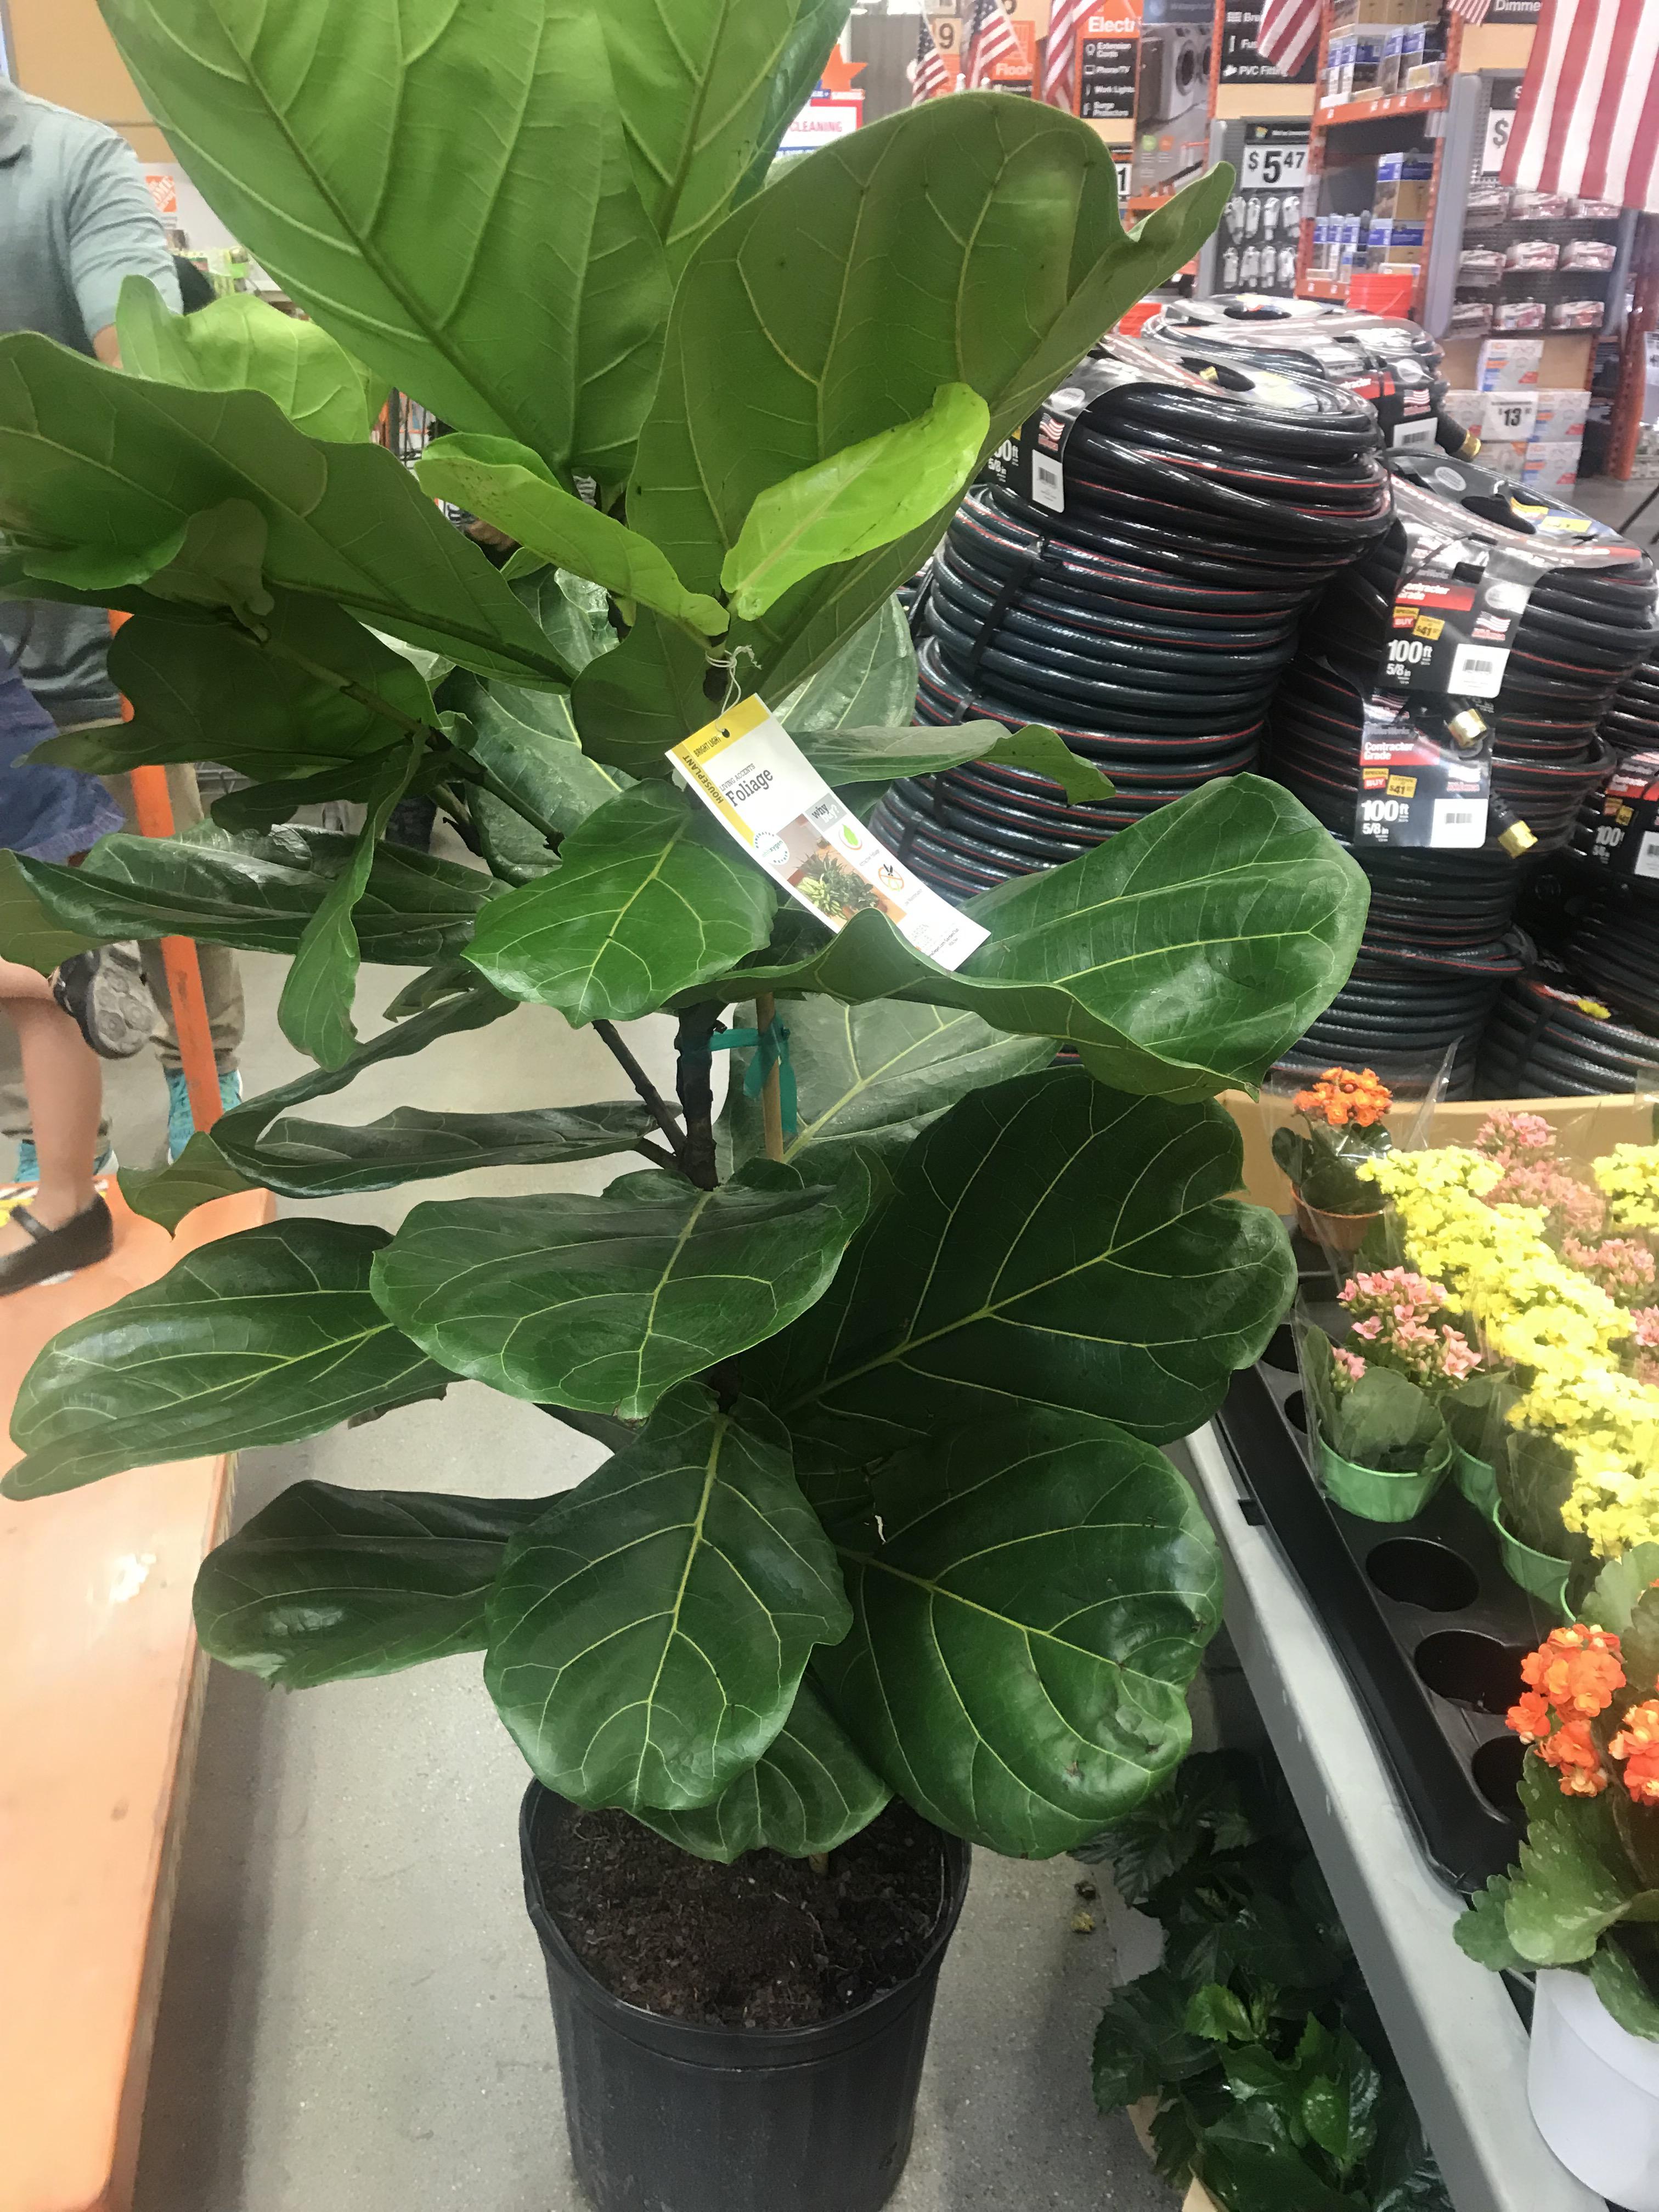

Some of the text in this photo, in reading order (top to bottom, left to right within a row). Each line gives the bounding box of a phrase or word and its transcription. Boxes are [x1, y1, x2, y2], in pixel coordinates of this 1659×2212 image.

[1494, 0, 1542, 11] Dimme
[939, 22, 953, 49] 9
[693, 735, 722, 758] BRIGHT LIGHT
[1364, 741, 1414, 752] Contractor
[1363, 751, 1392, 760] Grade
[682, 755, 724, 804] HOUSEPLANT
[719, 763, 756, 792] LIVING ACCENTS
[1366, 778, 1385, 787] BUY
[725, 769, 774, 807] Foliage
[811, 803, 831, 819] why
[1362, 822, 1381, 834] 5/8
